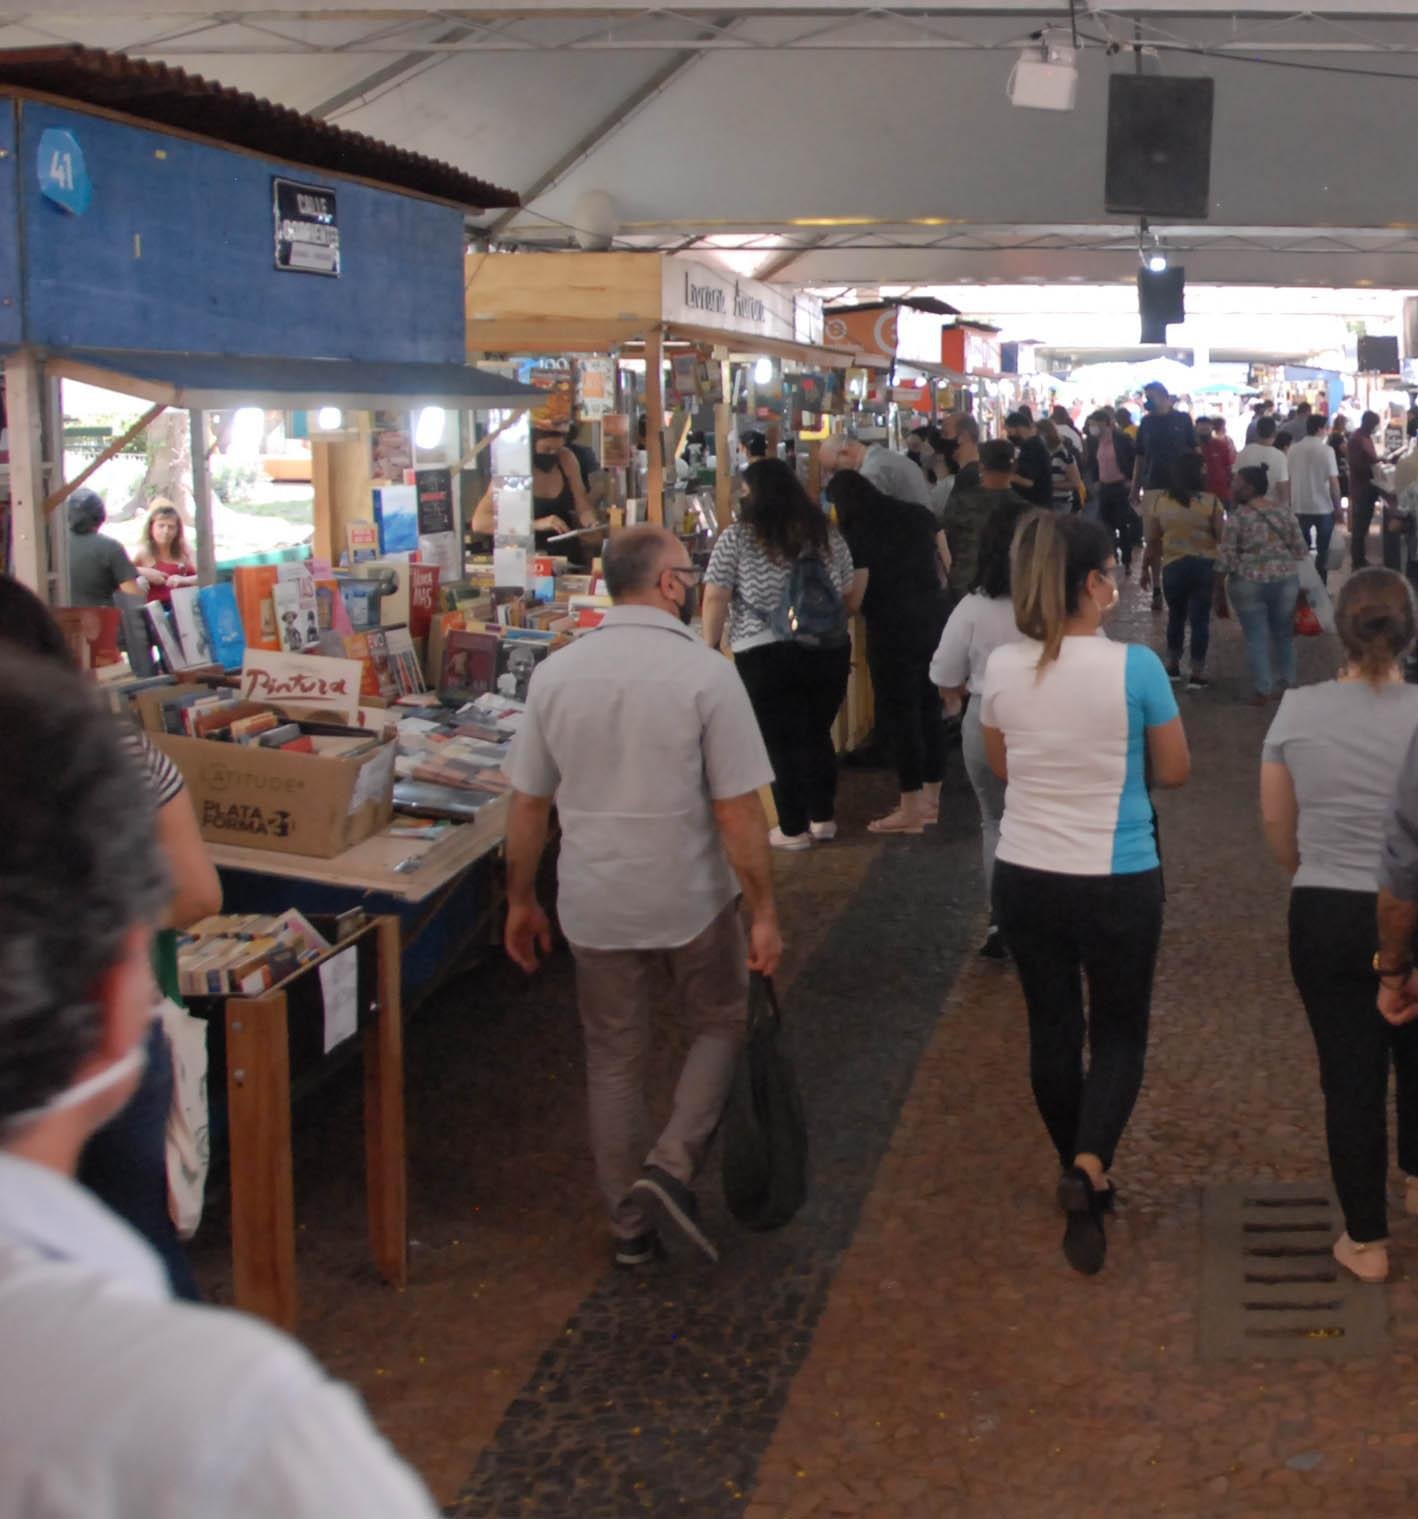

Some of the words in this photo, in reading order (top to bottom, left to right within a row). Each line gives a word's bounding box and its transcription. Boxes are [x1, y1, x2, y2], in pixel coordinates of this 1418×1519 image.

[49, 150, 74, 190] 41
[246, 669, 348, 701] Pintura
[203, 799, 262, 820] PLATA
[202, 813, 268, 836] FORMA
